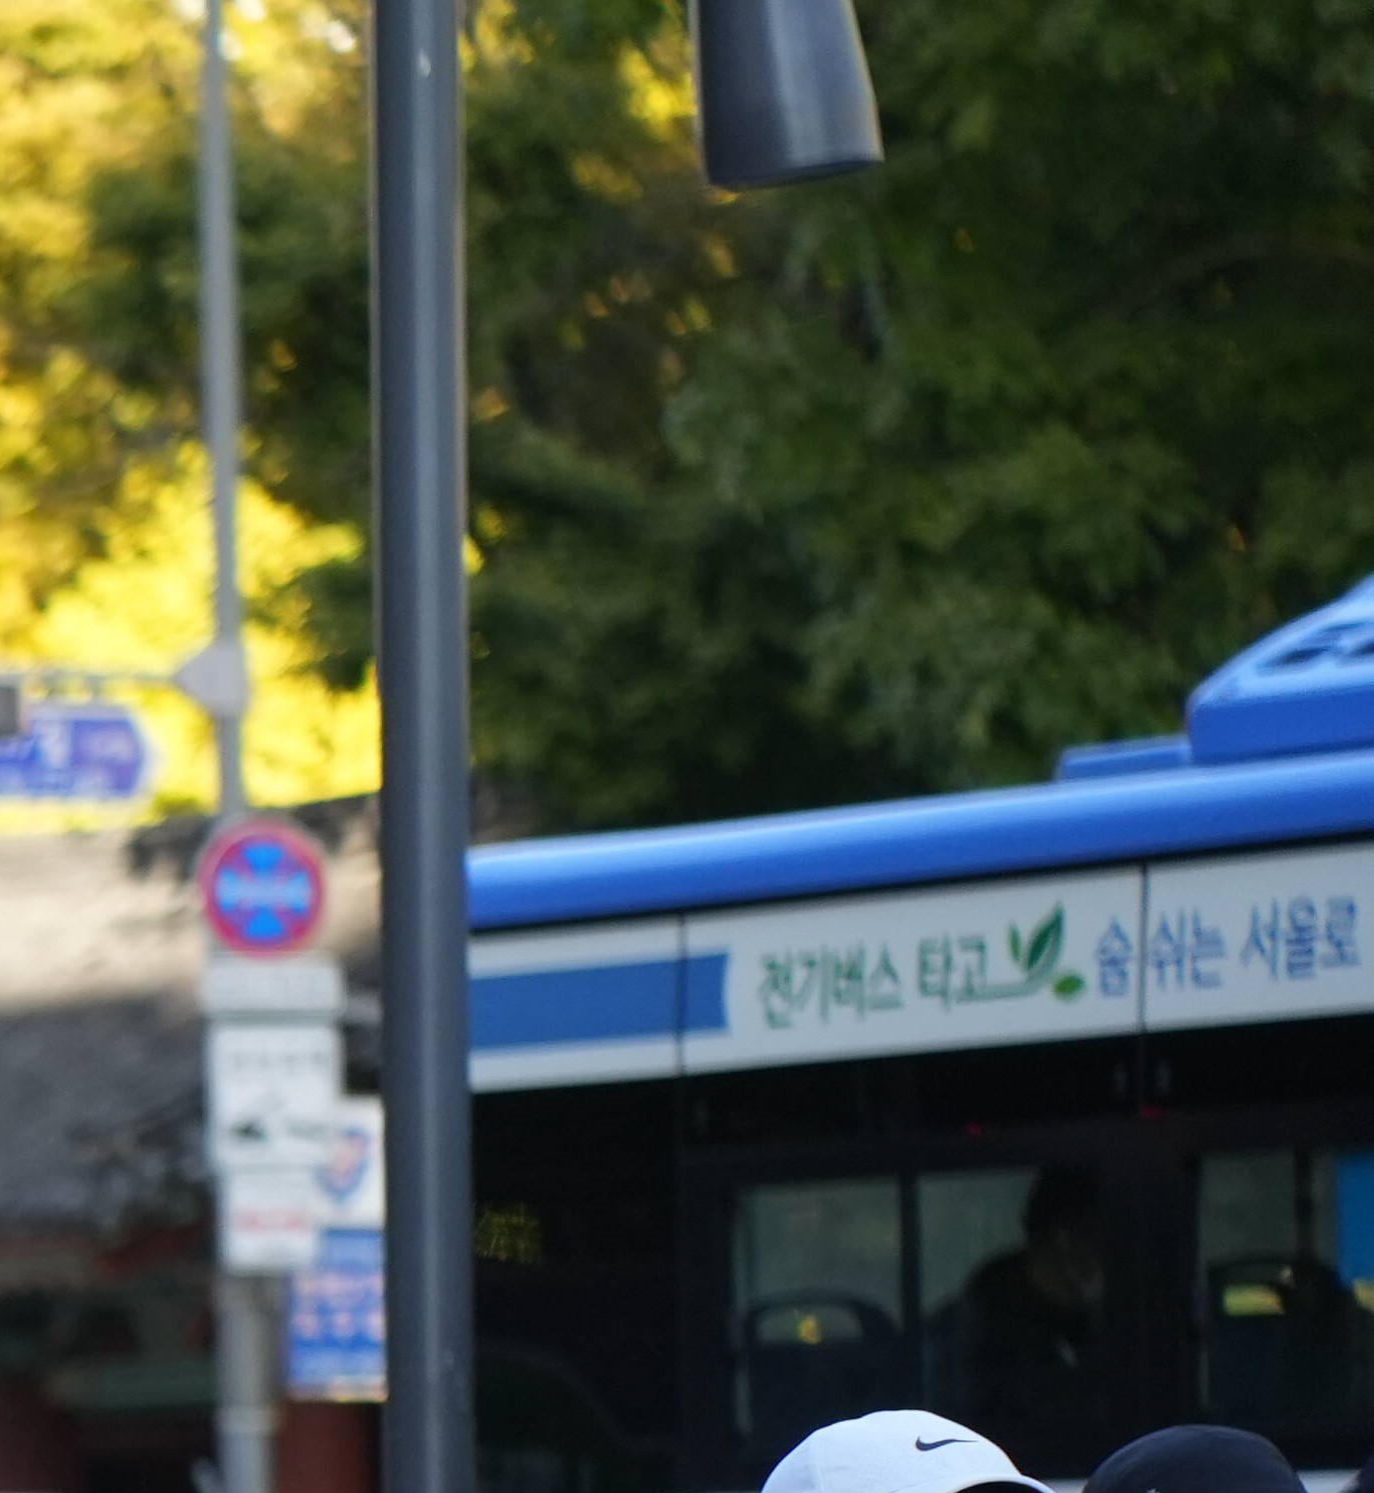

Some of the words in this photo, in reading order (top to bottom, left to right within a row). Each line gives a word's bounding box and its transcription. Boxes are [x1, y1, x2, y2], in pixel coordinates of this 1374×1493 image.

[758, 940, 903, 1028] 전기버스
[917, 934, 996, 1012] 타고
[1239, 897, 1361, 979] 서울로
